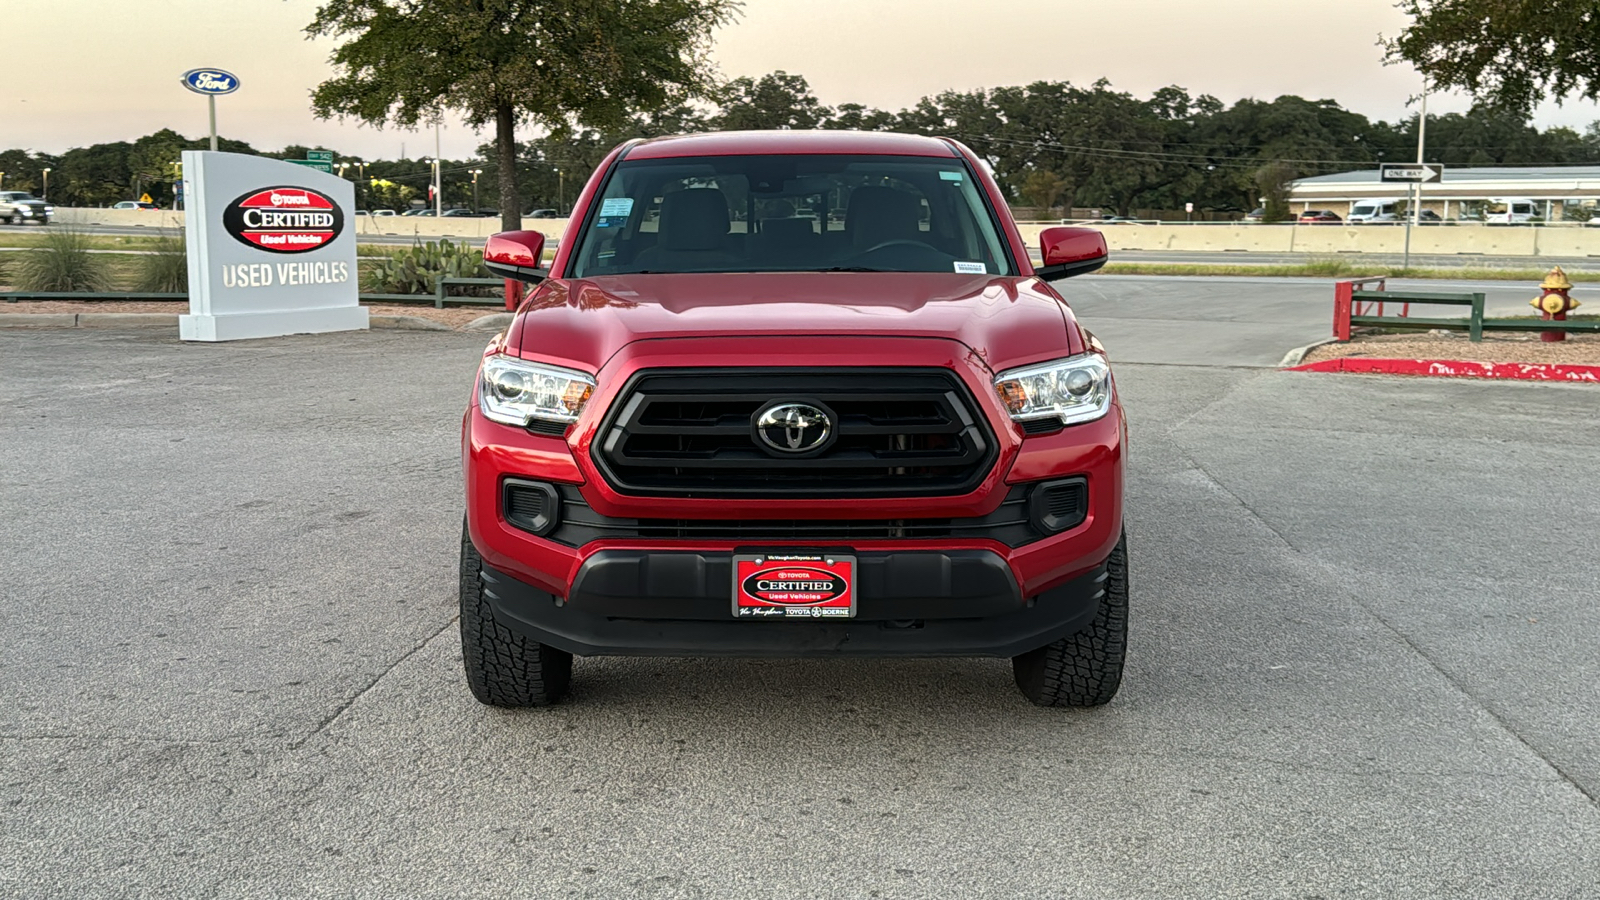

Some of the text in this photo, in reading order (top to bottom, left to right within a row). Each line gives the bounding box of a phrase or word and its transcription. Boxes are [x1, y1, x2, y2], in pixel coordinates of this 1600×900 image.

[195, 72, 230, 90] Ford
[282, 195, 310, 205] TOYOTA
[243, 208, 334, 228] CERTIFIED
[260, 234, 322, 244] Used Vehicles
[222, 261, 348, 288] USED VEHICLES
[757, 580, 833, 590] CERTIFIED
